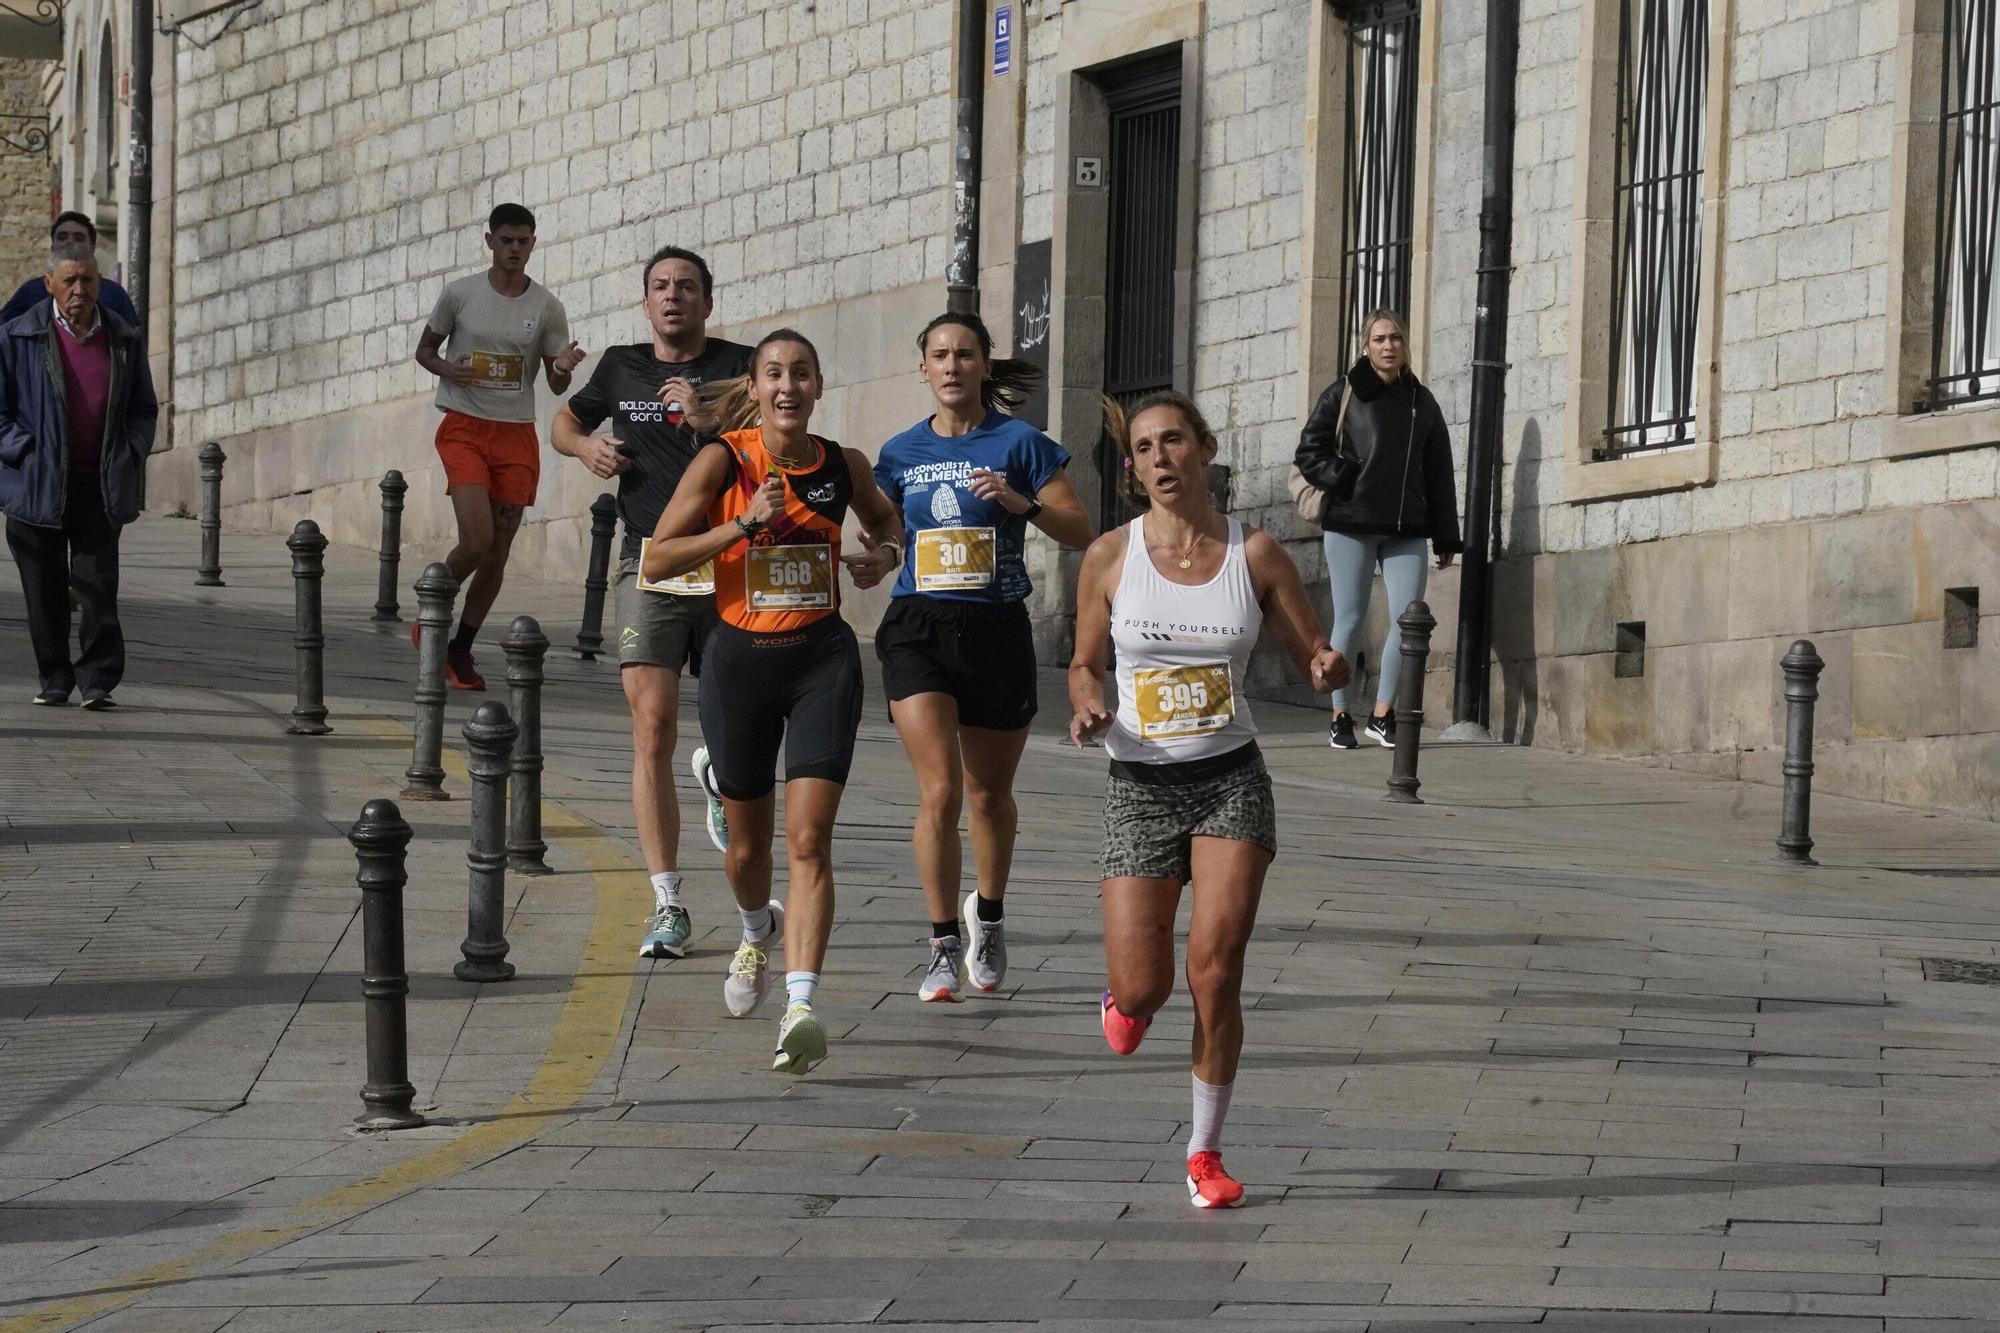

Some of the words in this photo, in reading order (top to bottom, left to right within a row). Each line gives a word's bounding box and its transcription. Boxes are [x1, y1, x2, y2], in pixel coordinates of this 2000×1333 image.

[1081, 161, 1096, 181] 5
[488, 362, 507, 377] 35
[903, 469, 914, 478] LA
[914, 460, 971, 475] CONQUISTA
[939, 543, 967, 567] 30
[769, 560, 812, 586] 568
[1125, 619, 1160, 629] PUSH
[1169, 623, 1246, 635] YOURSELF
[1211, 668, 1225, 677] 10K
[1157, 681, 1208, 713] 395
[1172, 711, 1198, 720] SANDRA
